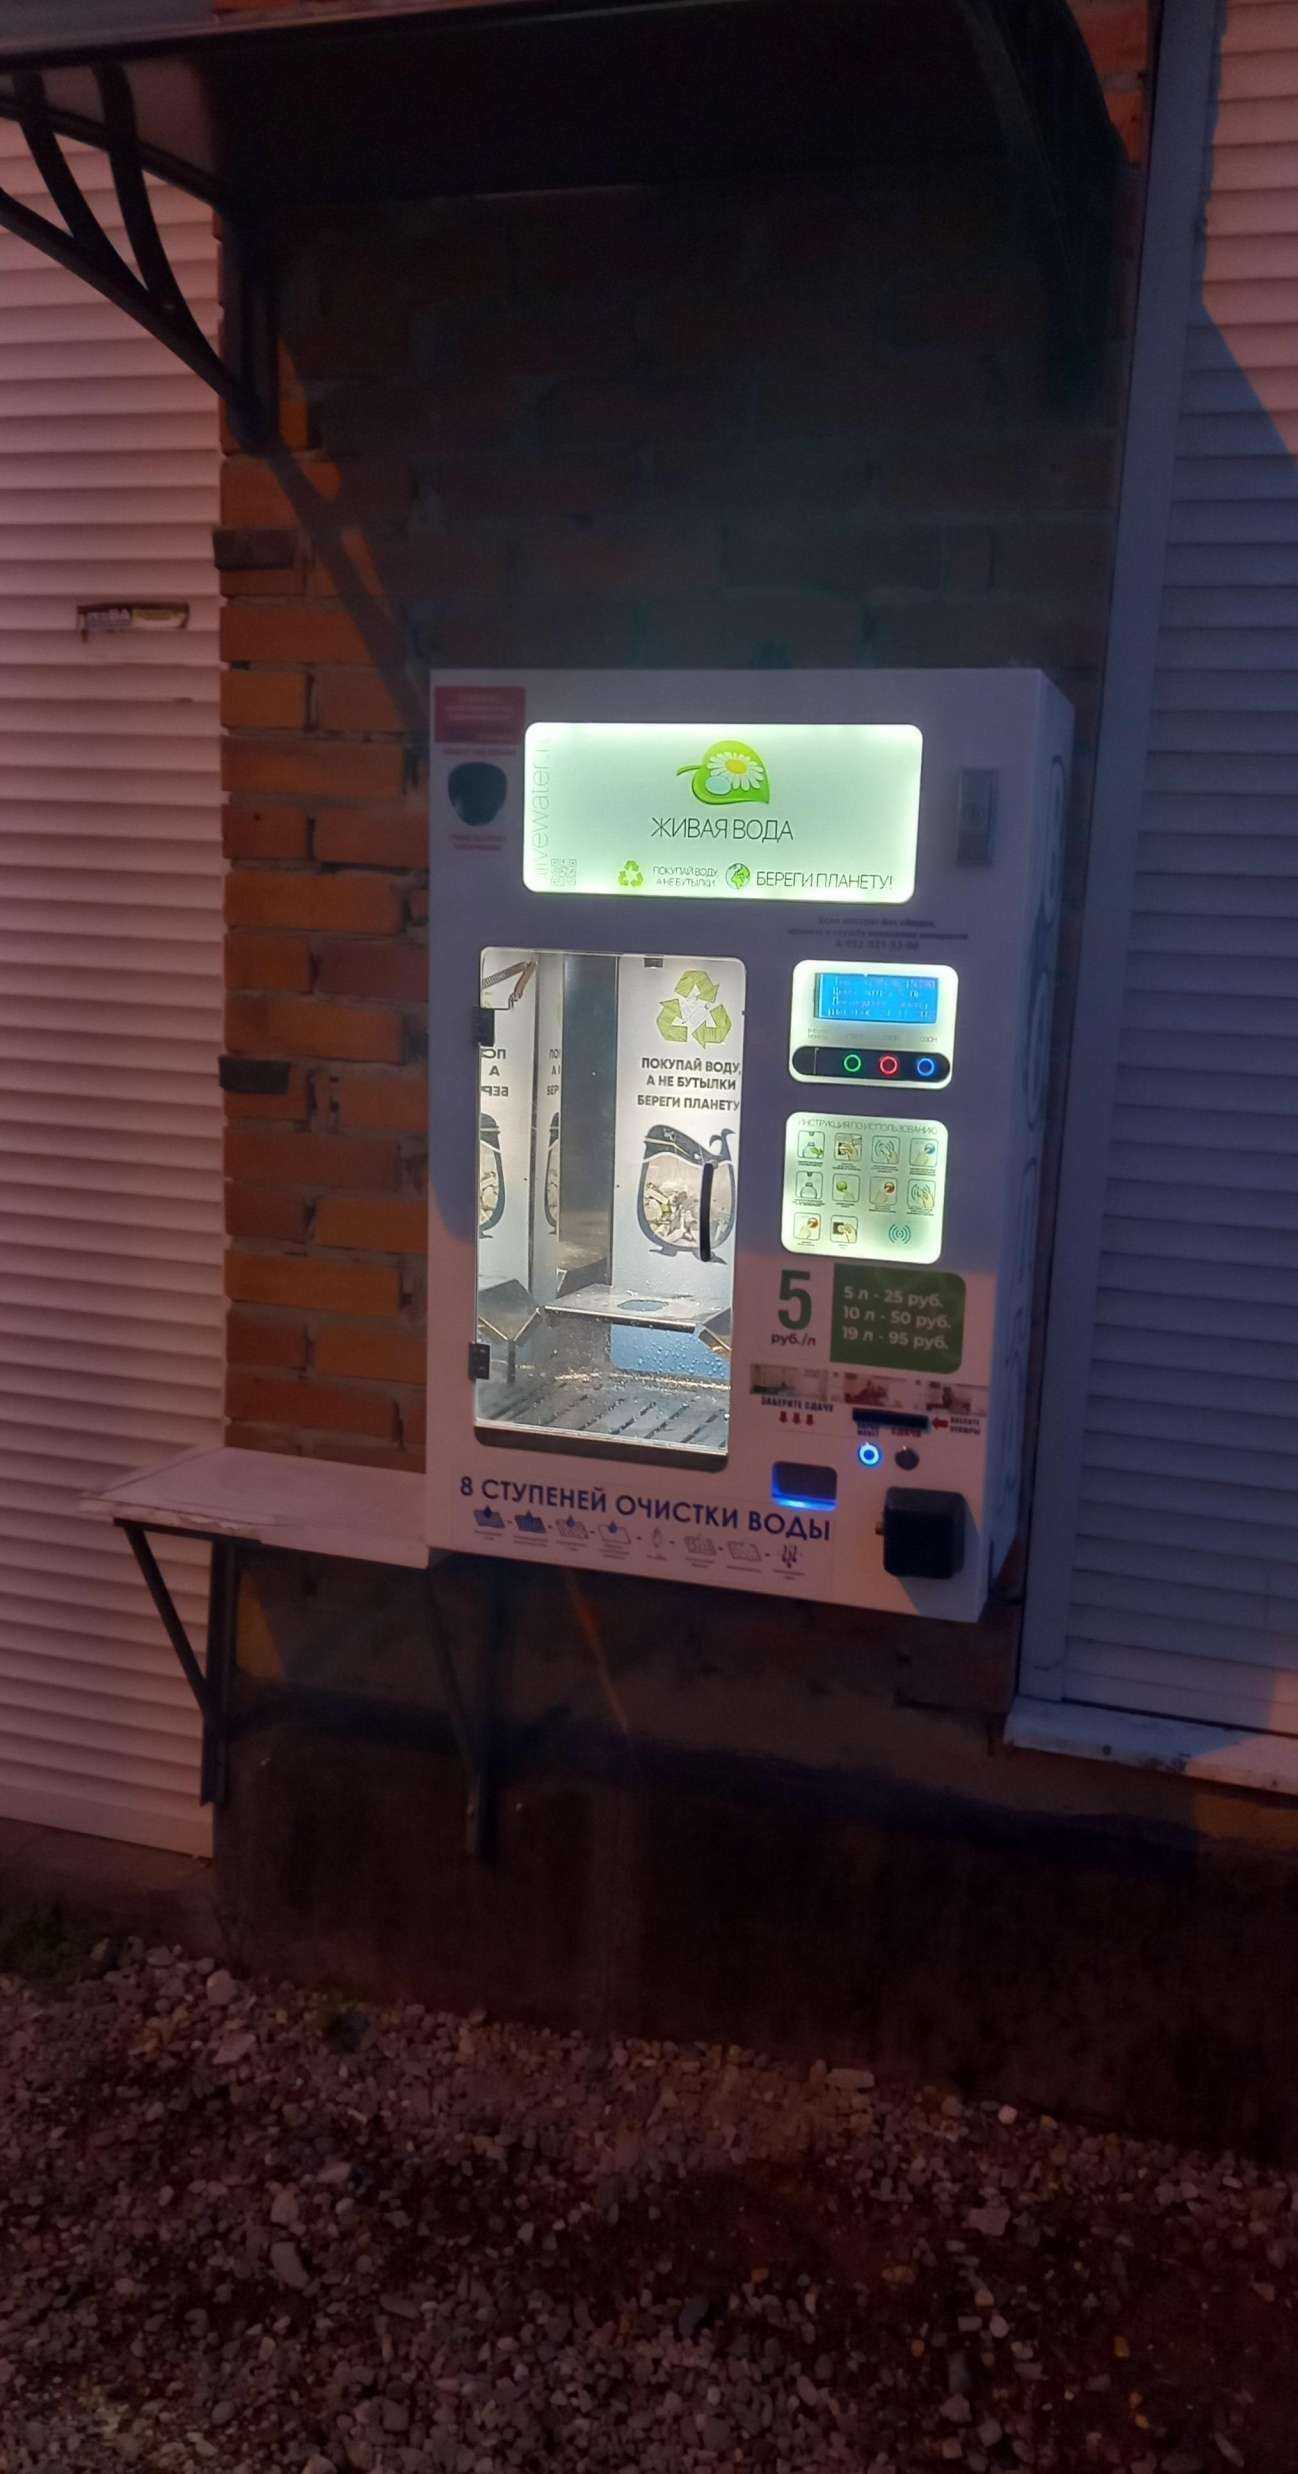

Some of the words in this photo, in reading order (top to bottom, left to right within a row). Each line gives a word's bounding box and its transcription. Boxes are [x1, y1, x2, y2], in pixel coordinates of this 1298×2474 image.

[651, 817, 728, 839] ЖИВАЯ
[732, 818, 794, 843] ВОДА
[756, 871, 814, 888] БЕРЕГИ
[816, 872, 893, 890] ПЛАНЕТУ!
[641, 1057, 702, 1071] ПОКУПАЙ
[705, 1061, 742, 1075] ВОДУ,
[646, 1076, 655, 1086] А
[658, 1076, 674, 1088] НЕ
[677, 1077, 736, 1091] БУТЫЛКИ
[637, 1094, 681, 1108] БЕРЕГИ
[684, 1097, 740, 1112] ПЛАНЕТУ
[778, 1269, 812, 1331] 5
[843, 1285, 853, 1299] 5
[857, 1288, 869, 1299] л
[884, 1289, 904, 1304] 25
[907, 1293, 944, 1309] руб.
[843, 1306, 860, 1320] 10
[863, 1310, 875, 1321] л
[890, 1311, 911, 1325] 50
[915, 1314, 952, 1330] руб.
[770, 1332, 816, 1347] руб./л
[842, 1326, 858, 1341] 19
[862, 1330, 874, 1341] л
[888, 1331, 909, 1345] 95
[913, 1334, 950, 1350] руб.
[460, 1476, 474, 1496] 8
[482, 1479, 607, 1512] СТУПЕНЕЙ
[616, 1494, 739, 1529] ОЧИСТКИ
[748, 1510, 831, 1541] ВОДЫ
